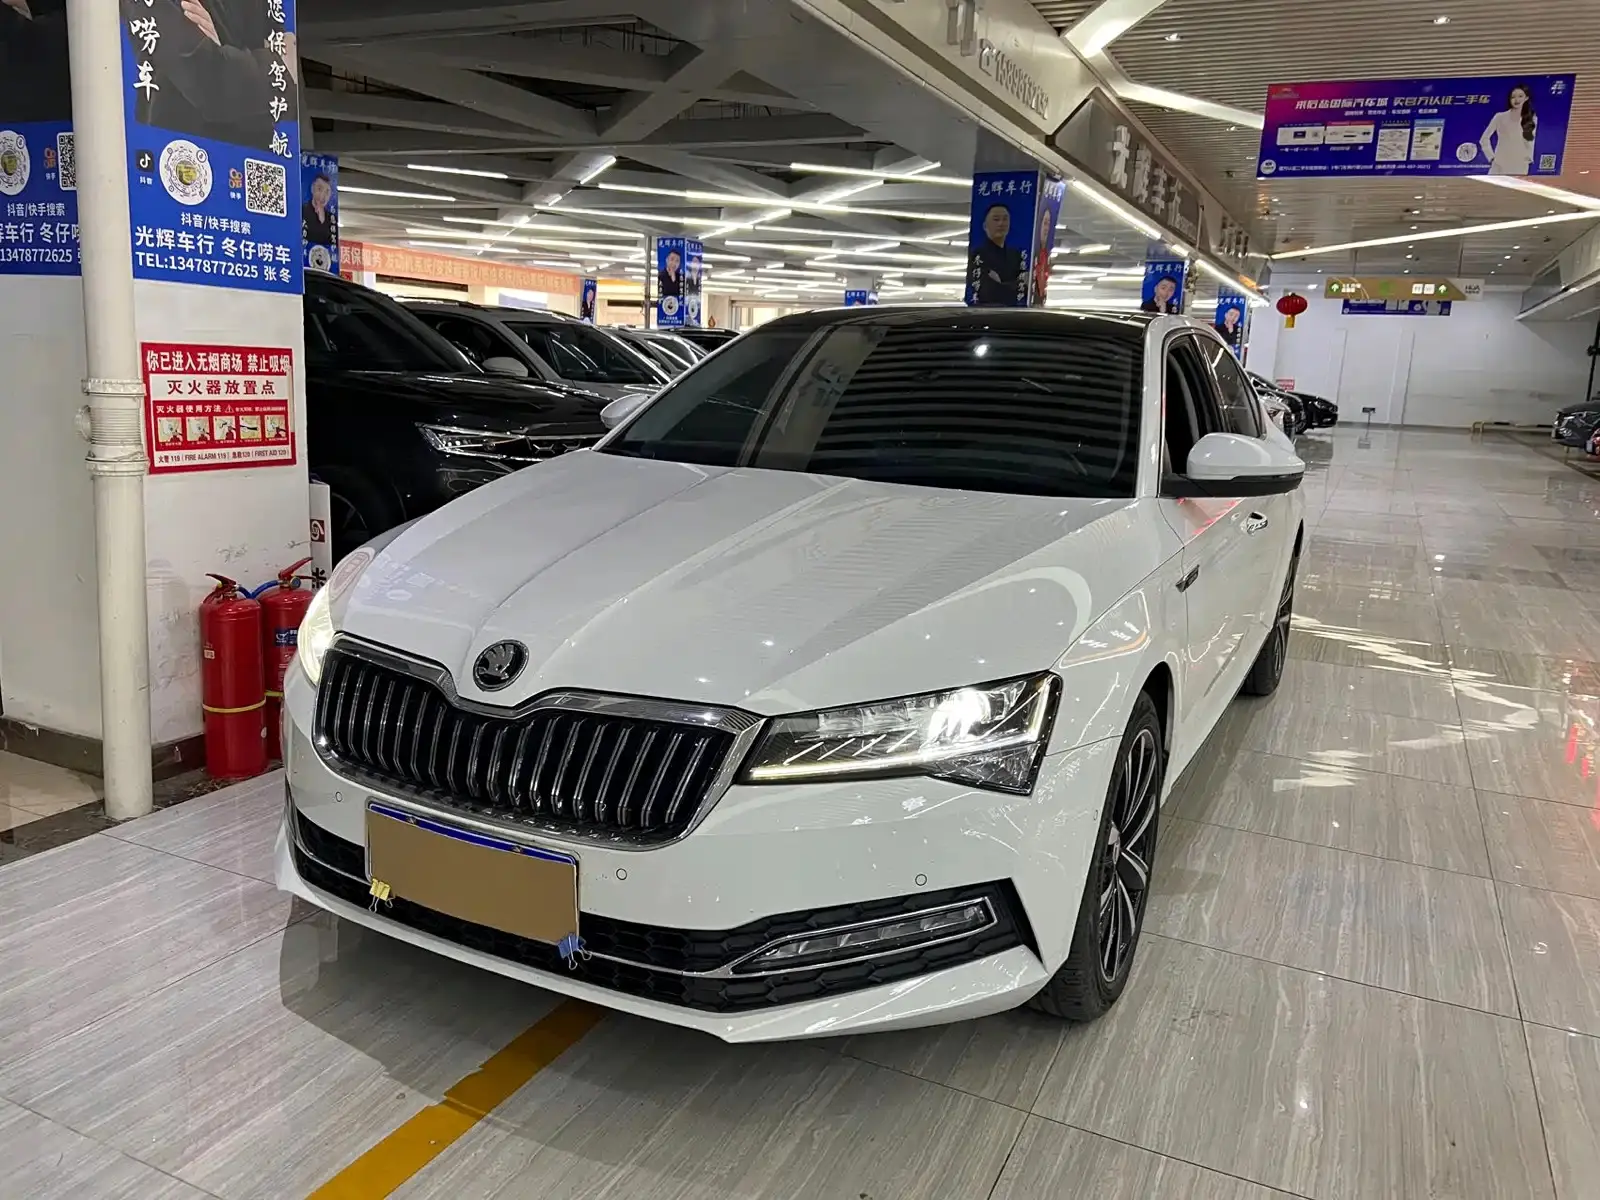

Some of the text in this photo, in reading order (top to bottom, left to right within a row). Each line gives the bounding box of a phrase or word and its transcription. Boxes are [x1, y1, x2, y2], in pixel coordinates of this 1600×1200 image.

[129, 0, 161, 101] 唠车
[267, 0, 293, 158] 您保驾护航
[7, 203, 65, 217] 抖音/快手搜索
[181, 212, 251, 235] 抖音/快手搜索
[135, 226, 215, 255] 光辉车行
[221, 237, 291, 265] 冬仔唠车
[135, 252, 292, 284] TEL:13478772625 张冬
[146, 350, 292, 373] 你已进入无烟商场 禁止吸烟
[167, 379, 275, 395] 灭火器放置点
[156, 404, 222, 413] 灭火器使用方法
[185, 453, 197, 461] FIRE
[198, 452, 217, 460] ALARM
[255, 449, 268, 457] FIRST
